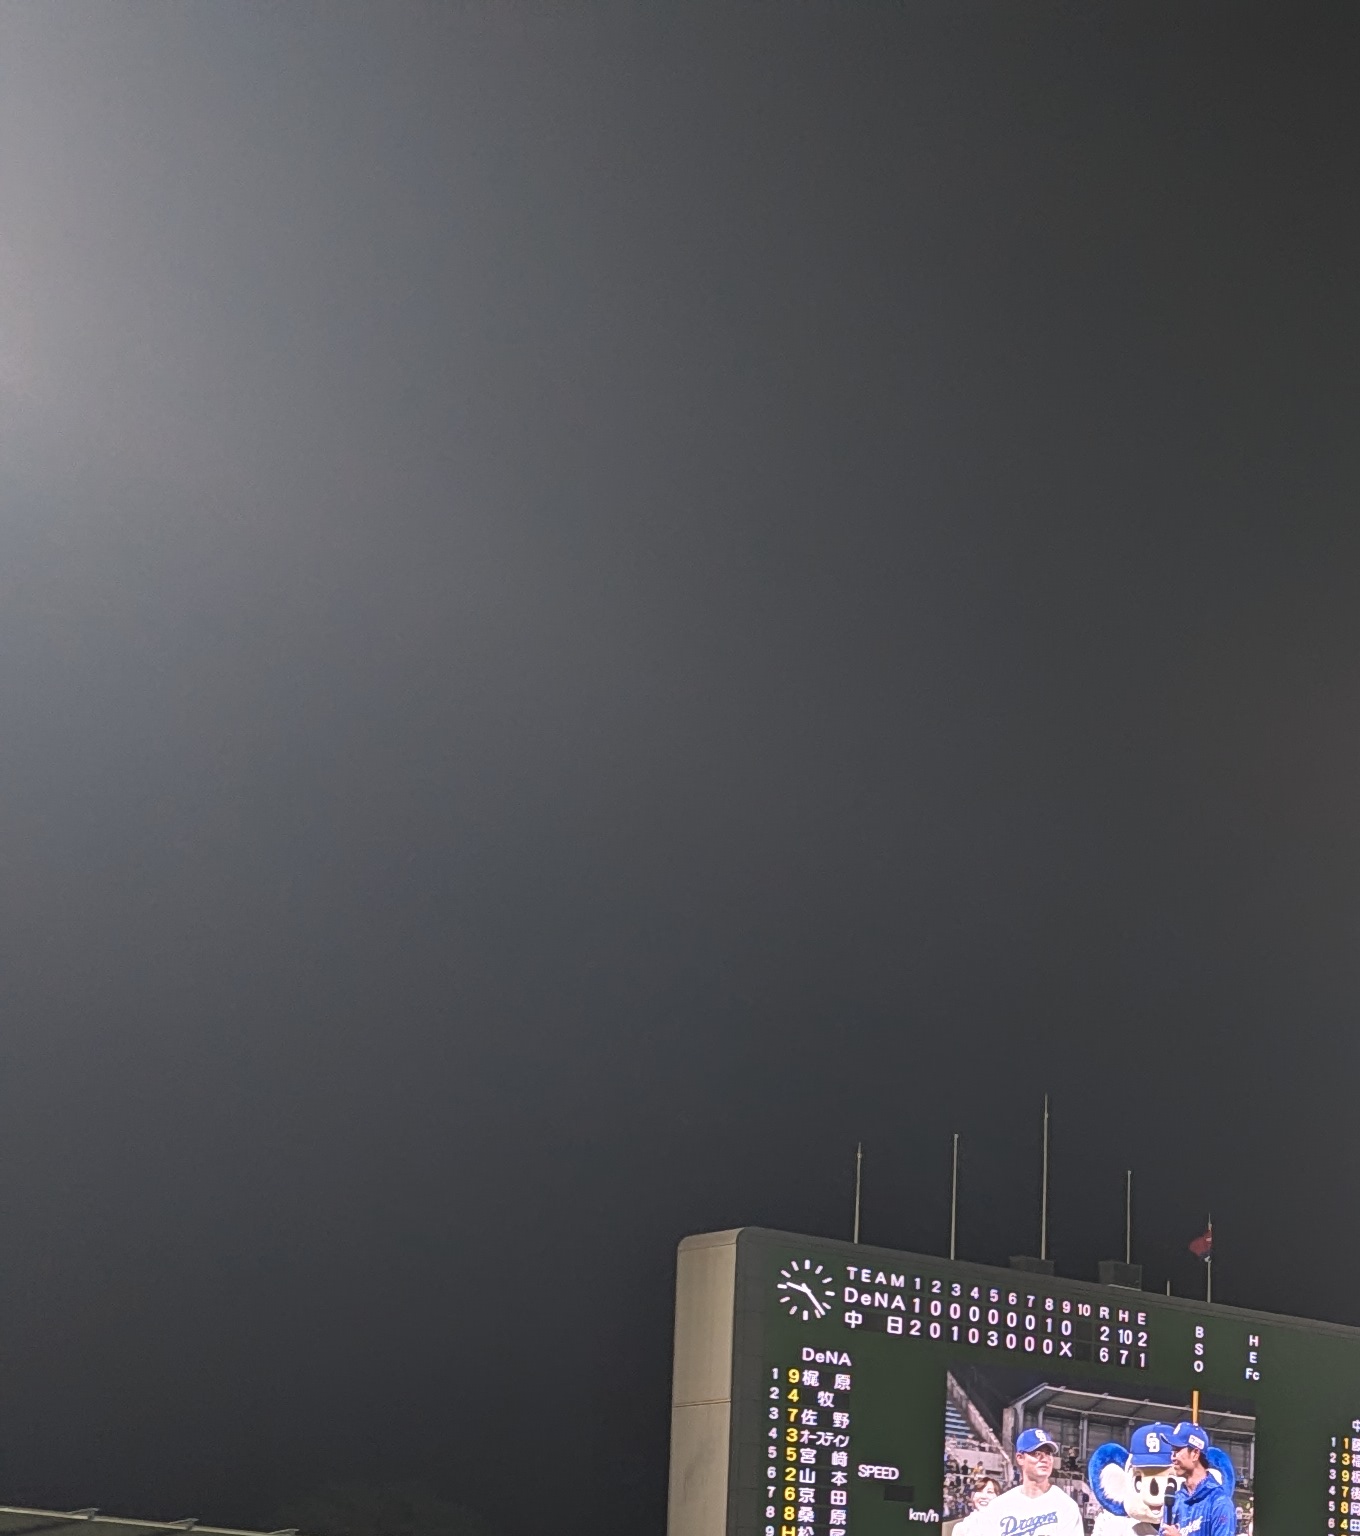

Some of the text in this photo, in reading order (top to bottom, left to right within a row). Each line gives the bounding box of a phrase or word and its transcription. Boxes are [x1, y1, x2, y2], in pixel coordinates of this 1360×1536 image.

[846, 1266, 1147, 1326] TEAM 1 2 3 4 5 6 7 8 9 10 R H E
[844, 1286, 1148, 1347] DeNA 1 0 0 0 0 0 0 1 0 2 10 2
[844, 1310, 1146, 1368] 中日 2 0 1 0 3 0 0 0 X 6 7 1
[1195, 1325, 1204, 1339] B
[1249, 1334, 1259, 1347] H
[802, 1347, 852, 1367] DeNA
[1194, 1343, 1204, 1356] S
[1249, 1351, 1258, 1364] E
[771, 1367, 779, 1380] 1
[788, 1368, 800, 1384] 9
[1245, 1367, 1260, 1381] Fc
[769, 1386, 835, 1408] 2 4 牧
[768, 1406, 850, 1429] 3 7 佐野
[768, 1427, 778, 1439] 4
[785, 1427, 798, 1443] 3
[1330, 1436, 1337, 1448] 1
[1343, 1437, 1349, 1450] 1
[767, 1446, 777, 1459] 5
[786, 1447, 797, 1461] 5
[1329, 1452, 1337, 1464] 2
[1341, 1453, 1350, 1466] 3
[767, 1466, 848, 1487] 6 2 山本
[857, 1463, 900, 1480] SPEED
[1328, 1468, 1337, 1480] 3
[1341, 1469, 1350, 1482] 9
[766, 1486, 847, 1506] 7 6 京田
[1328, 1485, 1336, 1496] 4
[1341, 1485, 1349, 1498] 7
[1328, 1500, 1336, 1512] 5
[1340, 1501, 1349, 1514] 8
[765, 1505, 847, 1526] 8 8 桑原
[908, 1508, 940, 1524] km/h
[1327, 1517, 1335, 1529] 6
[1340, 1518, 1348, 1530] 4
